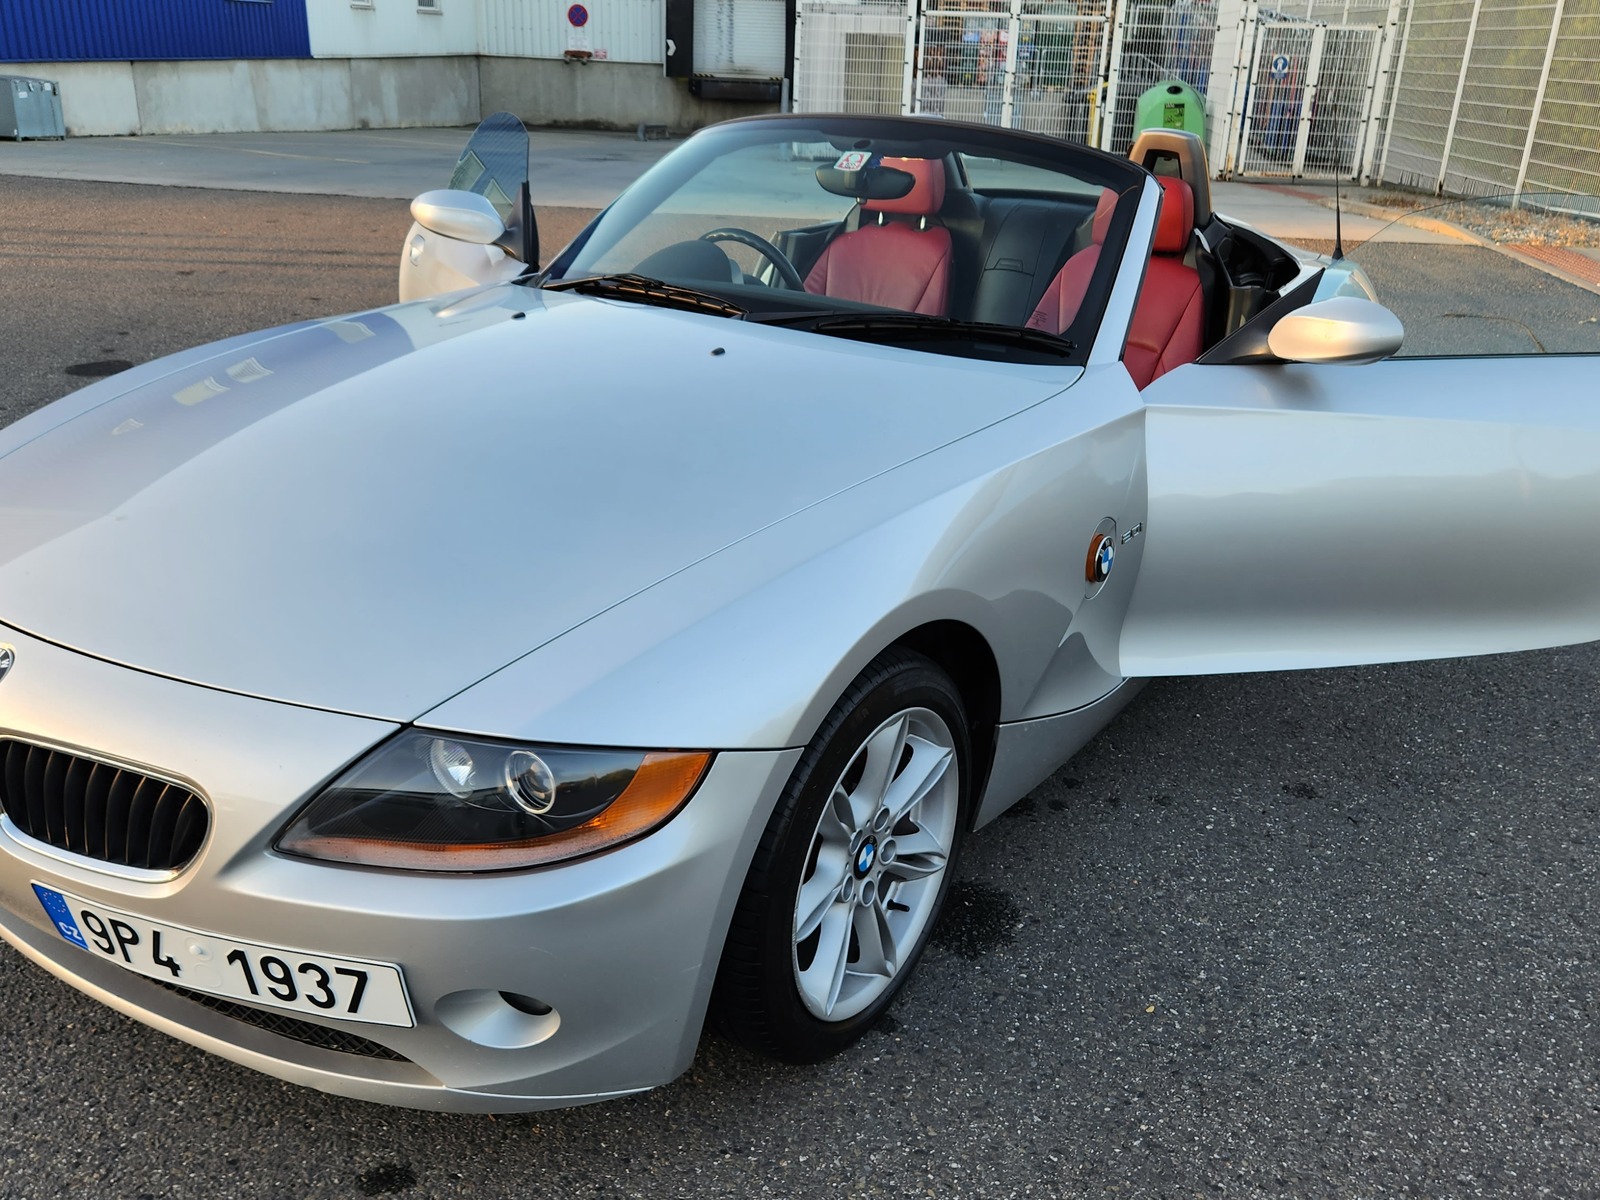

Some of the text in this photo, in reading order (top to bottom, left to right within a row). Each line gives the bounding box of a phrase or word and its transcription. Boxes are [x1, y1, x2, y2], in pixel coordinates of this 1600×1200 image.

[58, 921, 83, 941] CZ
[80, 909, 369, 1014] 9P4 1937
